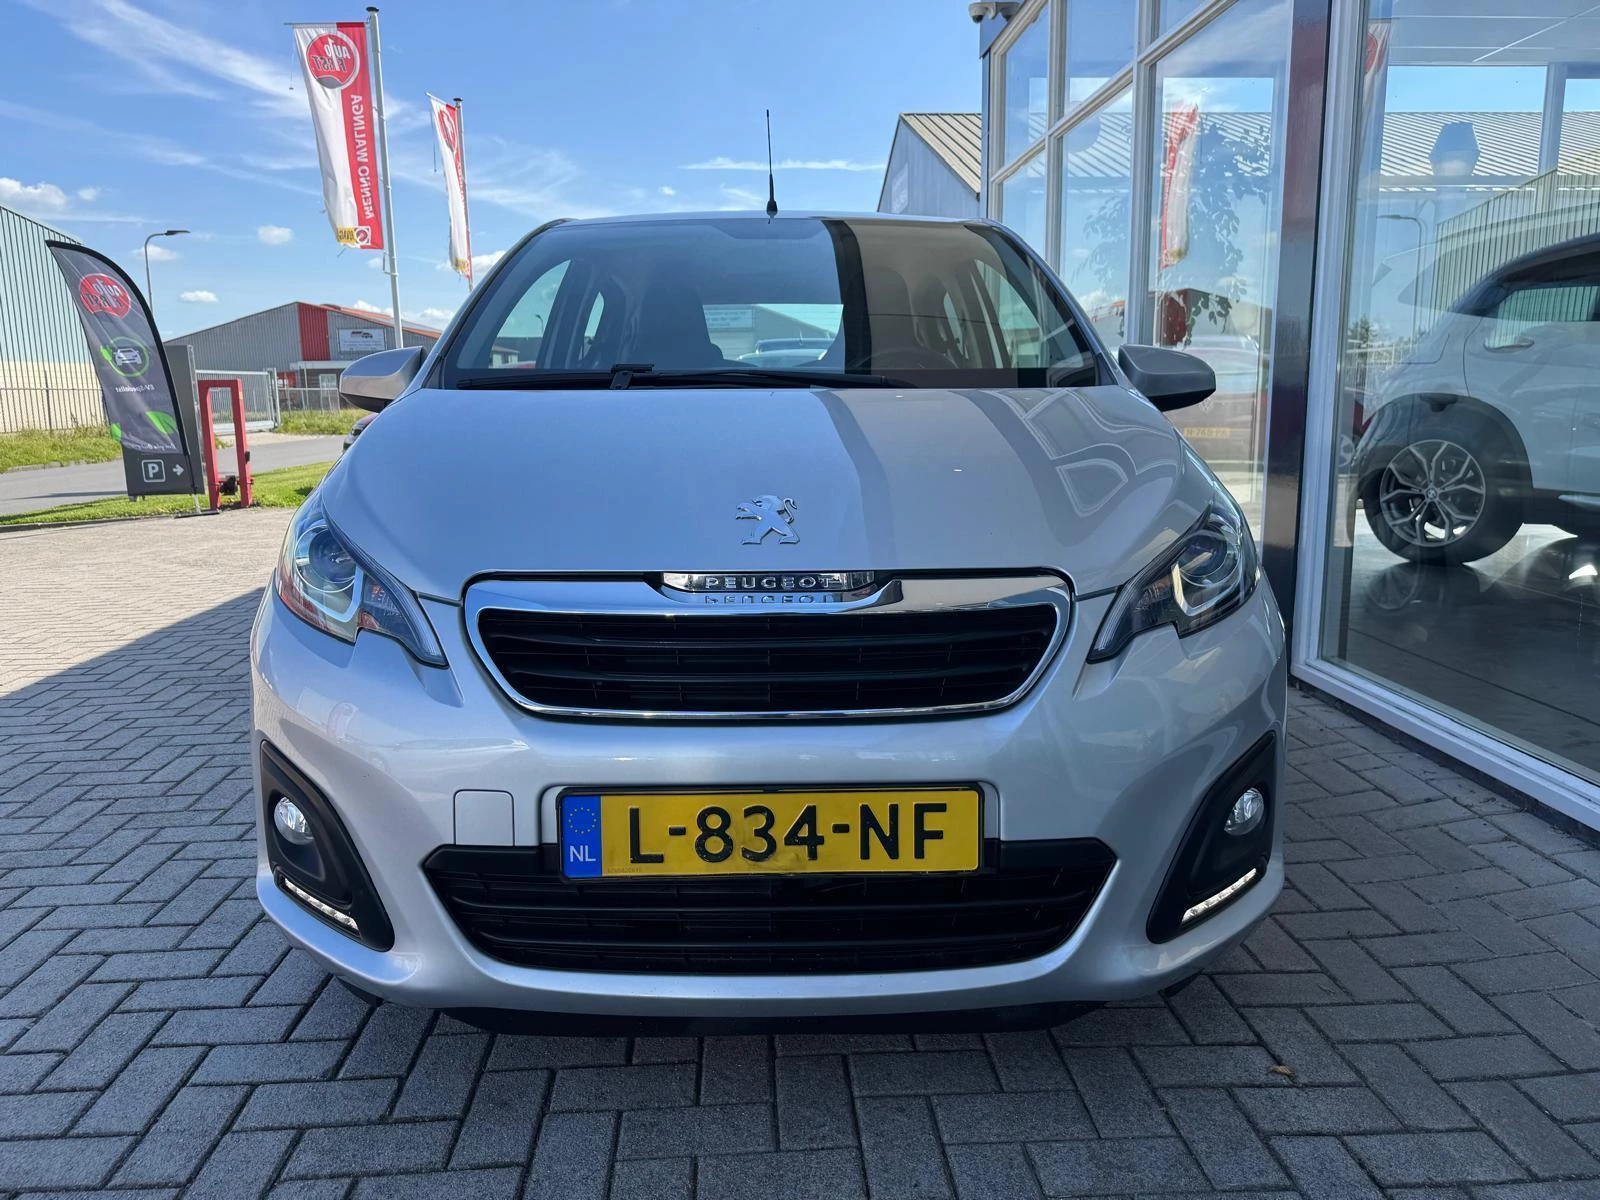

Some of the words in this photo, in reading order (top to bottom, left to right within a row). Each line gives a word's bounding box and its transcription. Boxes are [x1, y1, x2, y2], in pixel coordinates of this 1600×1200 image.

[148, 465, 159, 477] P
[705, 576, 832, 589] PEUGEOT
[629, 803, 948, 864] L-834-NF
[569, 845, 596, 862] NL
